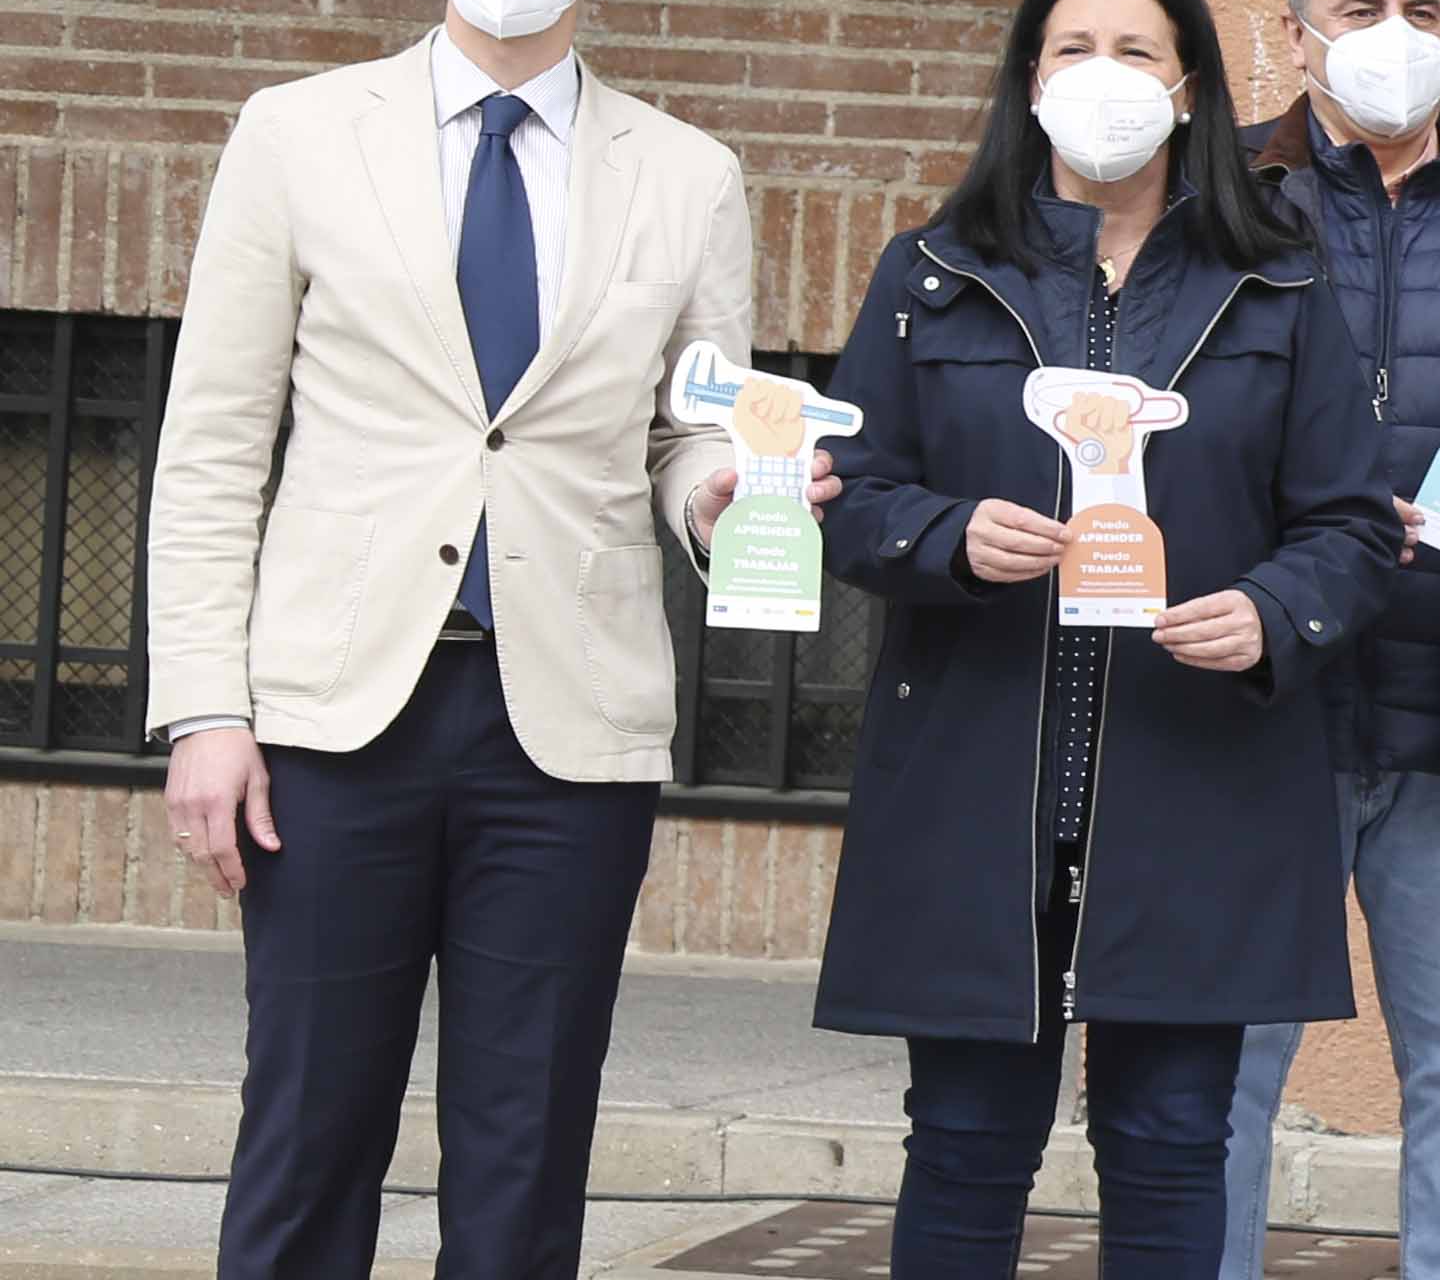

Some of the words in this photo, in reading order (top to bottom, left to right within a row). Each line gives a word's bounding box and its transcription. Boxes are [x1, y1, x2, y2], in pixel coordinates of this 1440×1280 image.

[749, 510, 788, 522] Puedo
[1092, 519, 1130, 529] Puedo
[733, 524, 802, 537] APRENDER
[1078, 533, 1144, 543] APRENDER
[1092, 551, 1131, 561] Puedo
[733, 558, 799, 571] TRABAJAR
[1079, 564, 1144, 574] TRABAJAR
